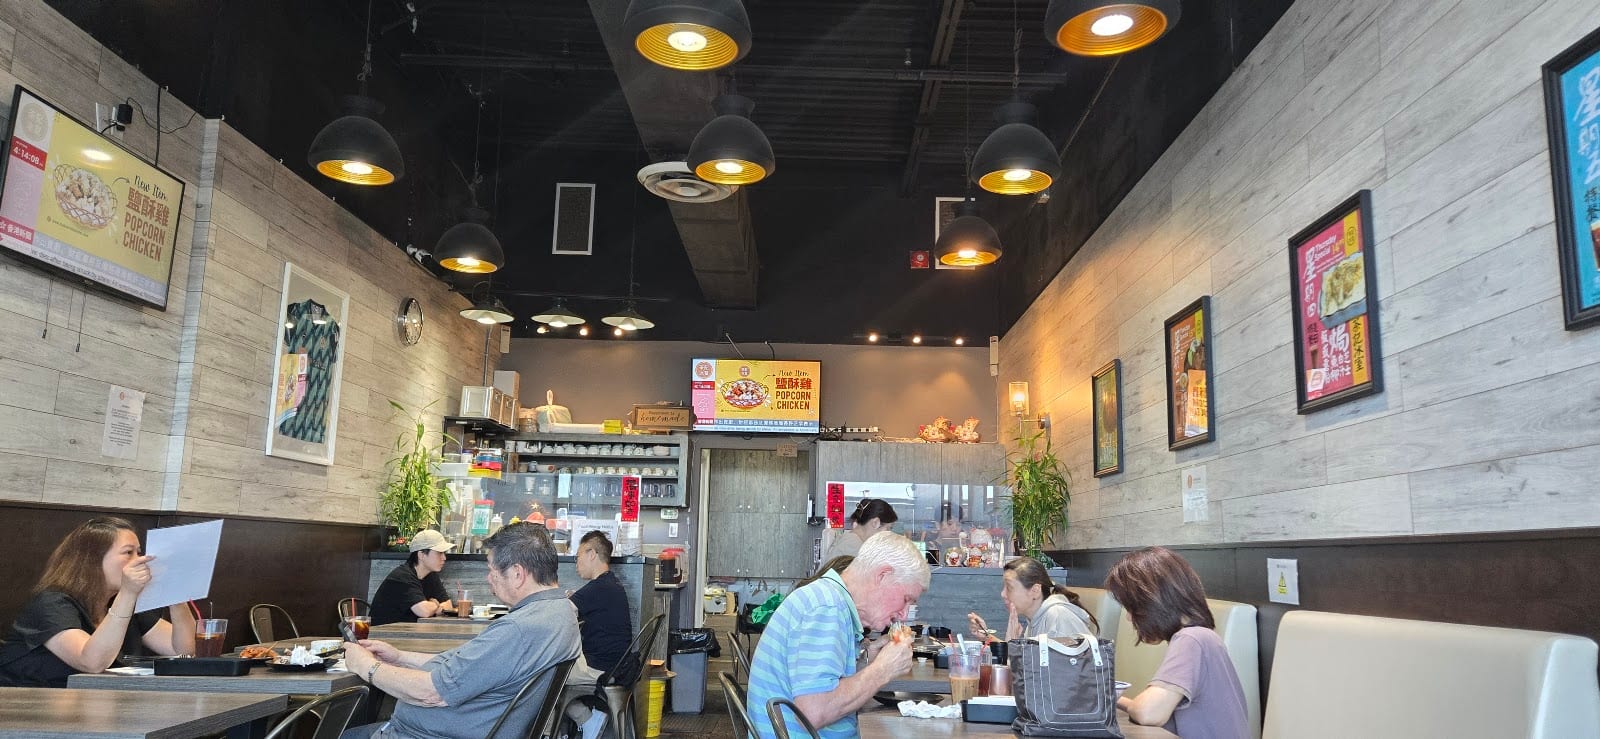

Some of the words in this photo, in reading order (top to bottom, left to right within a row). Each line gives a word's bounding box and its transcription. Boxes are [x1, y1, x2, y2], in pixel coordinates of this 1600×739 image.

[135, 175, 150, 192] New
[126, 187, 170, 227] 鹽酥雞
[124, 212, 166, 246] POPCORN
[123, 231, 162, 262] CHICKEN
[775, 377, 812, 390] 鹽酥雞
[776, 391, 811, 400] POPCORN
[777, 401, 810, 410] CHICKEN
